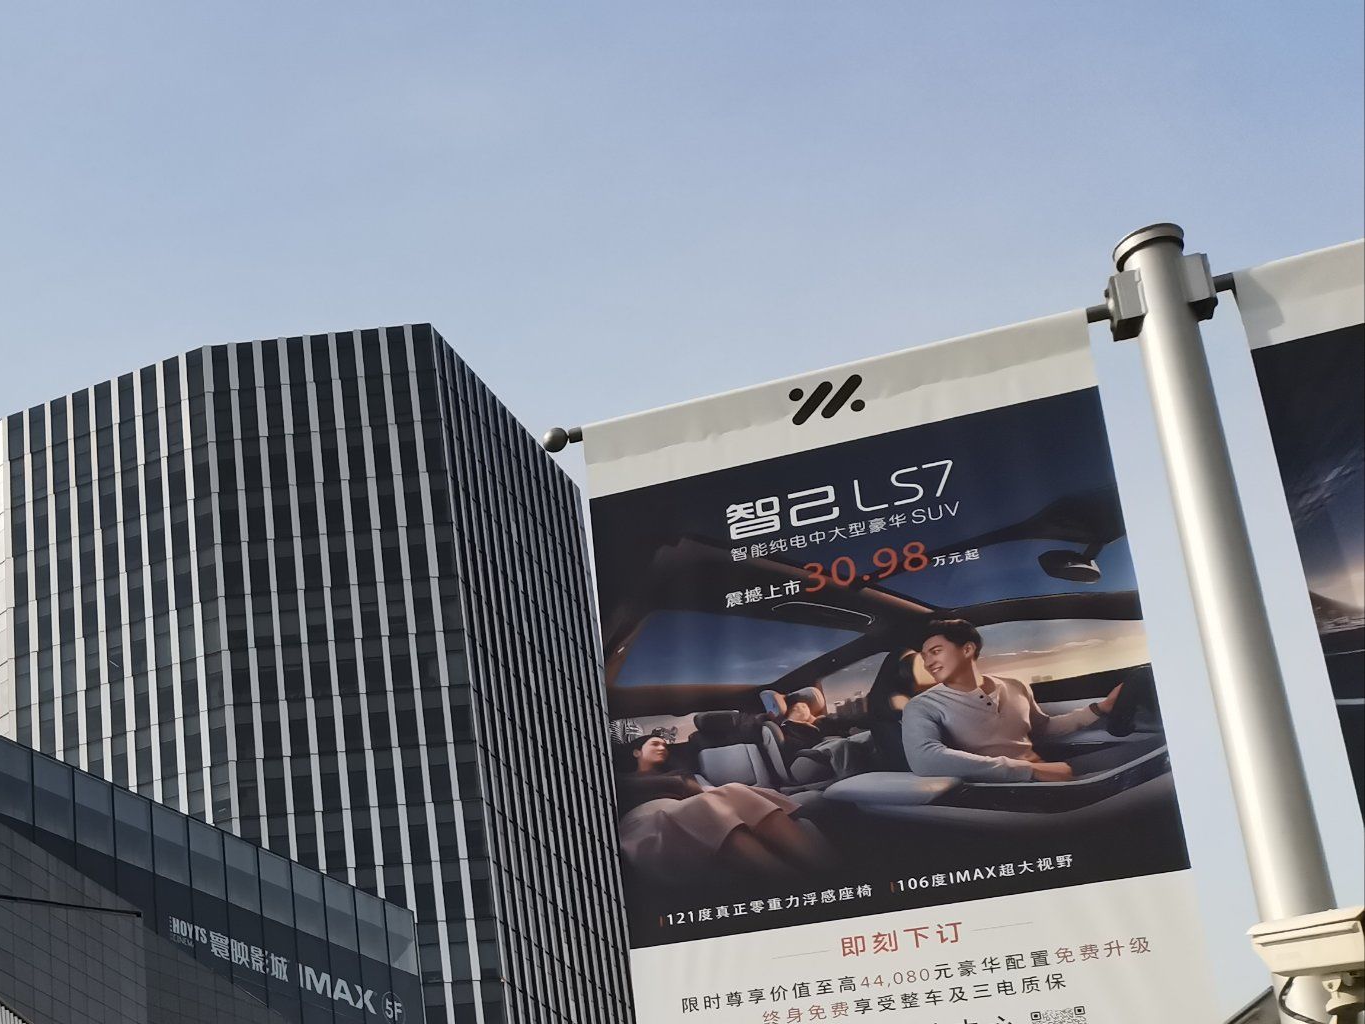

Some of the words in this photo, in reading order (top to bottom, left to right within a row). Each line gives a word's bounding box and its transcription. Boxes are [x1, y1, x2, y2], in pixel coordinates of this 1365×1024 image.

[726, 485, 840, 540] 智己
[853, 459, 953, 512] LS7
[897, 853, 1074, 892] 106度IMAX超大视野
[172, 916, 208, 944] HOYTS
[298, 963, 377, 1015] IMAX
[384, 1000, 403, 1020] 5F
[840, 921, 962, 957] 即刻下订
